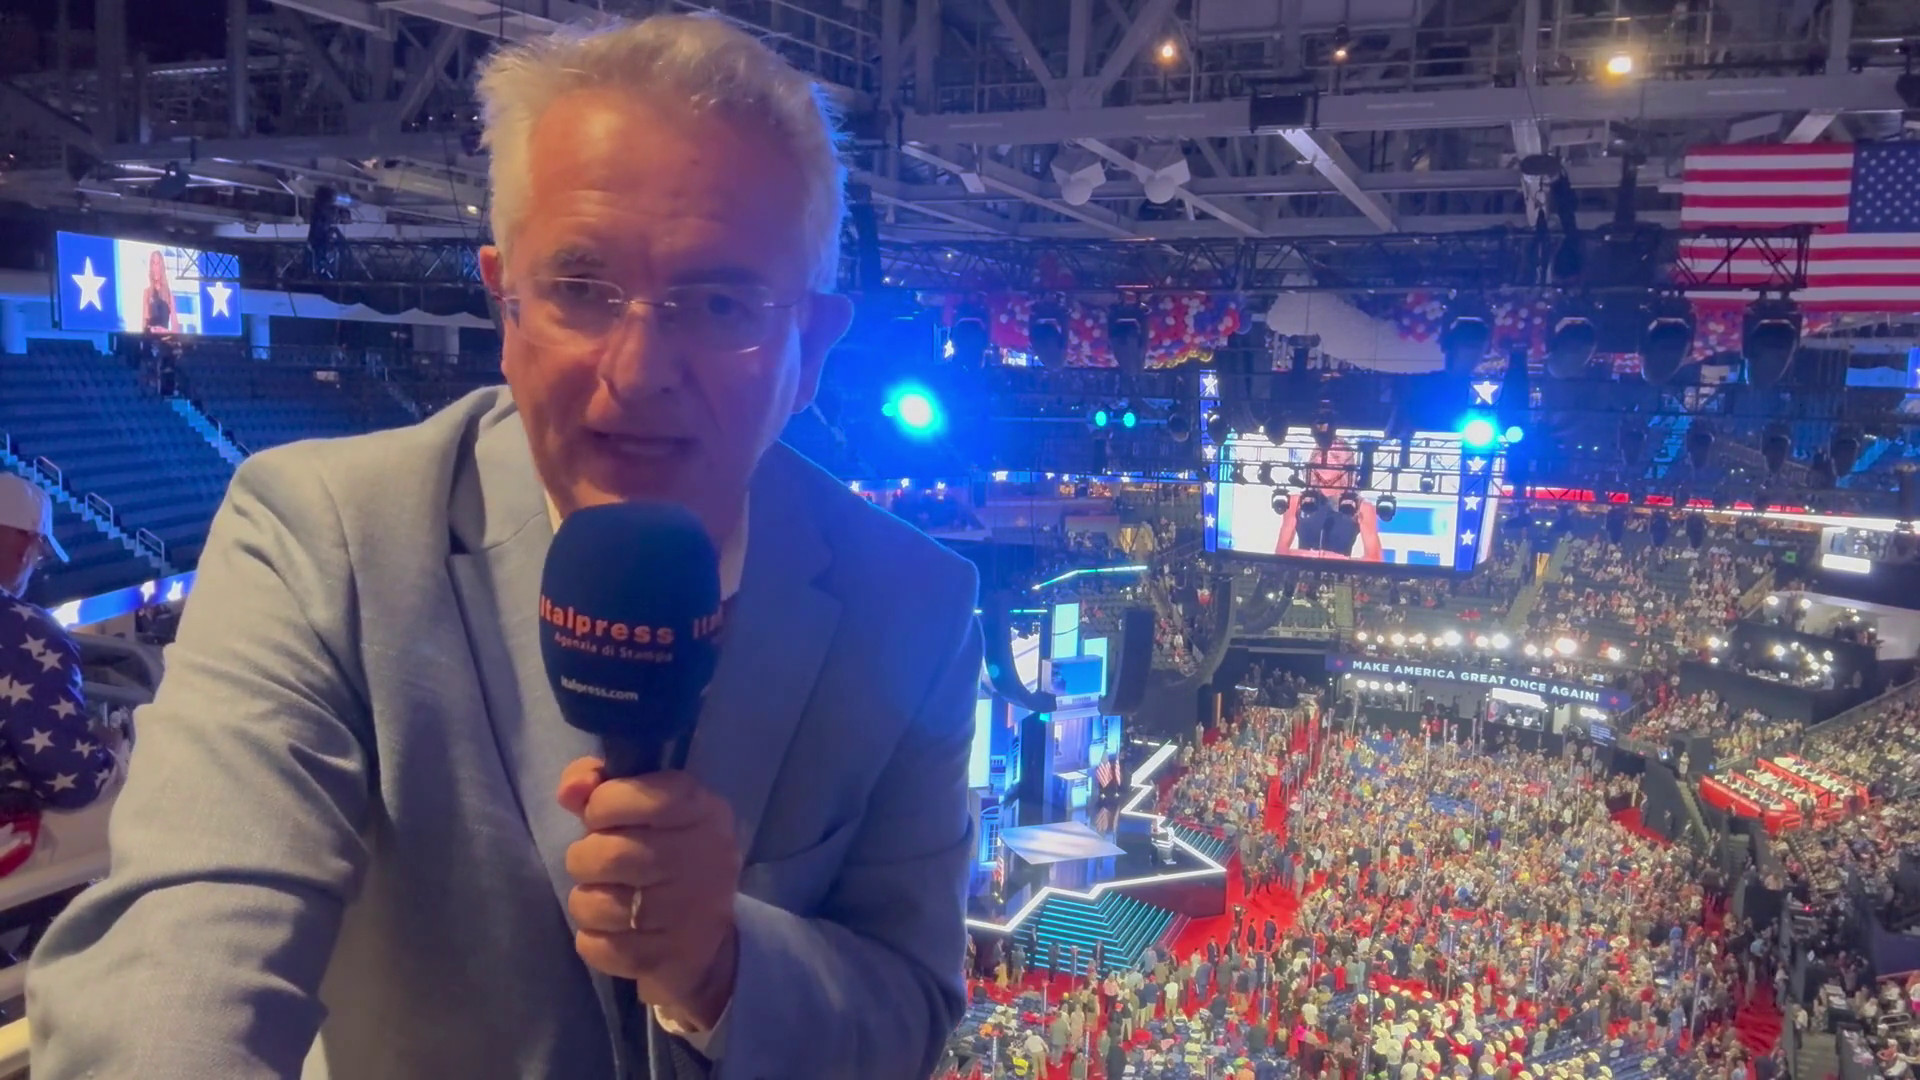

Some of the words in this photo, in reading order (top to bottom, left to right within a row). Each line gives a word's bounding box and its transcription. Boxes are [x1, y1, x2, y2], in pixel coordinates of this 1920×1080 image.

[540, 594, 674, 645] Italpress
[554, 631, 597, 652] Agenzia
[601, 645, 614, 656] di
[619, 646, 673, 663] Stampa
[1352, 661, 1390, 672] MAKE
[1394, 665, 1455, 679] AMERICA
[1460, 672, 1505, 684] GREAT
[1510, 678, 1546, 692] ONCE
[1551, 685, 1600, 702] AGAIN!
